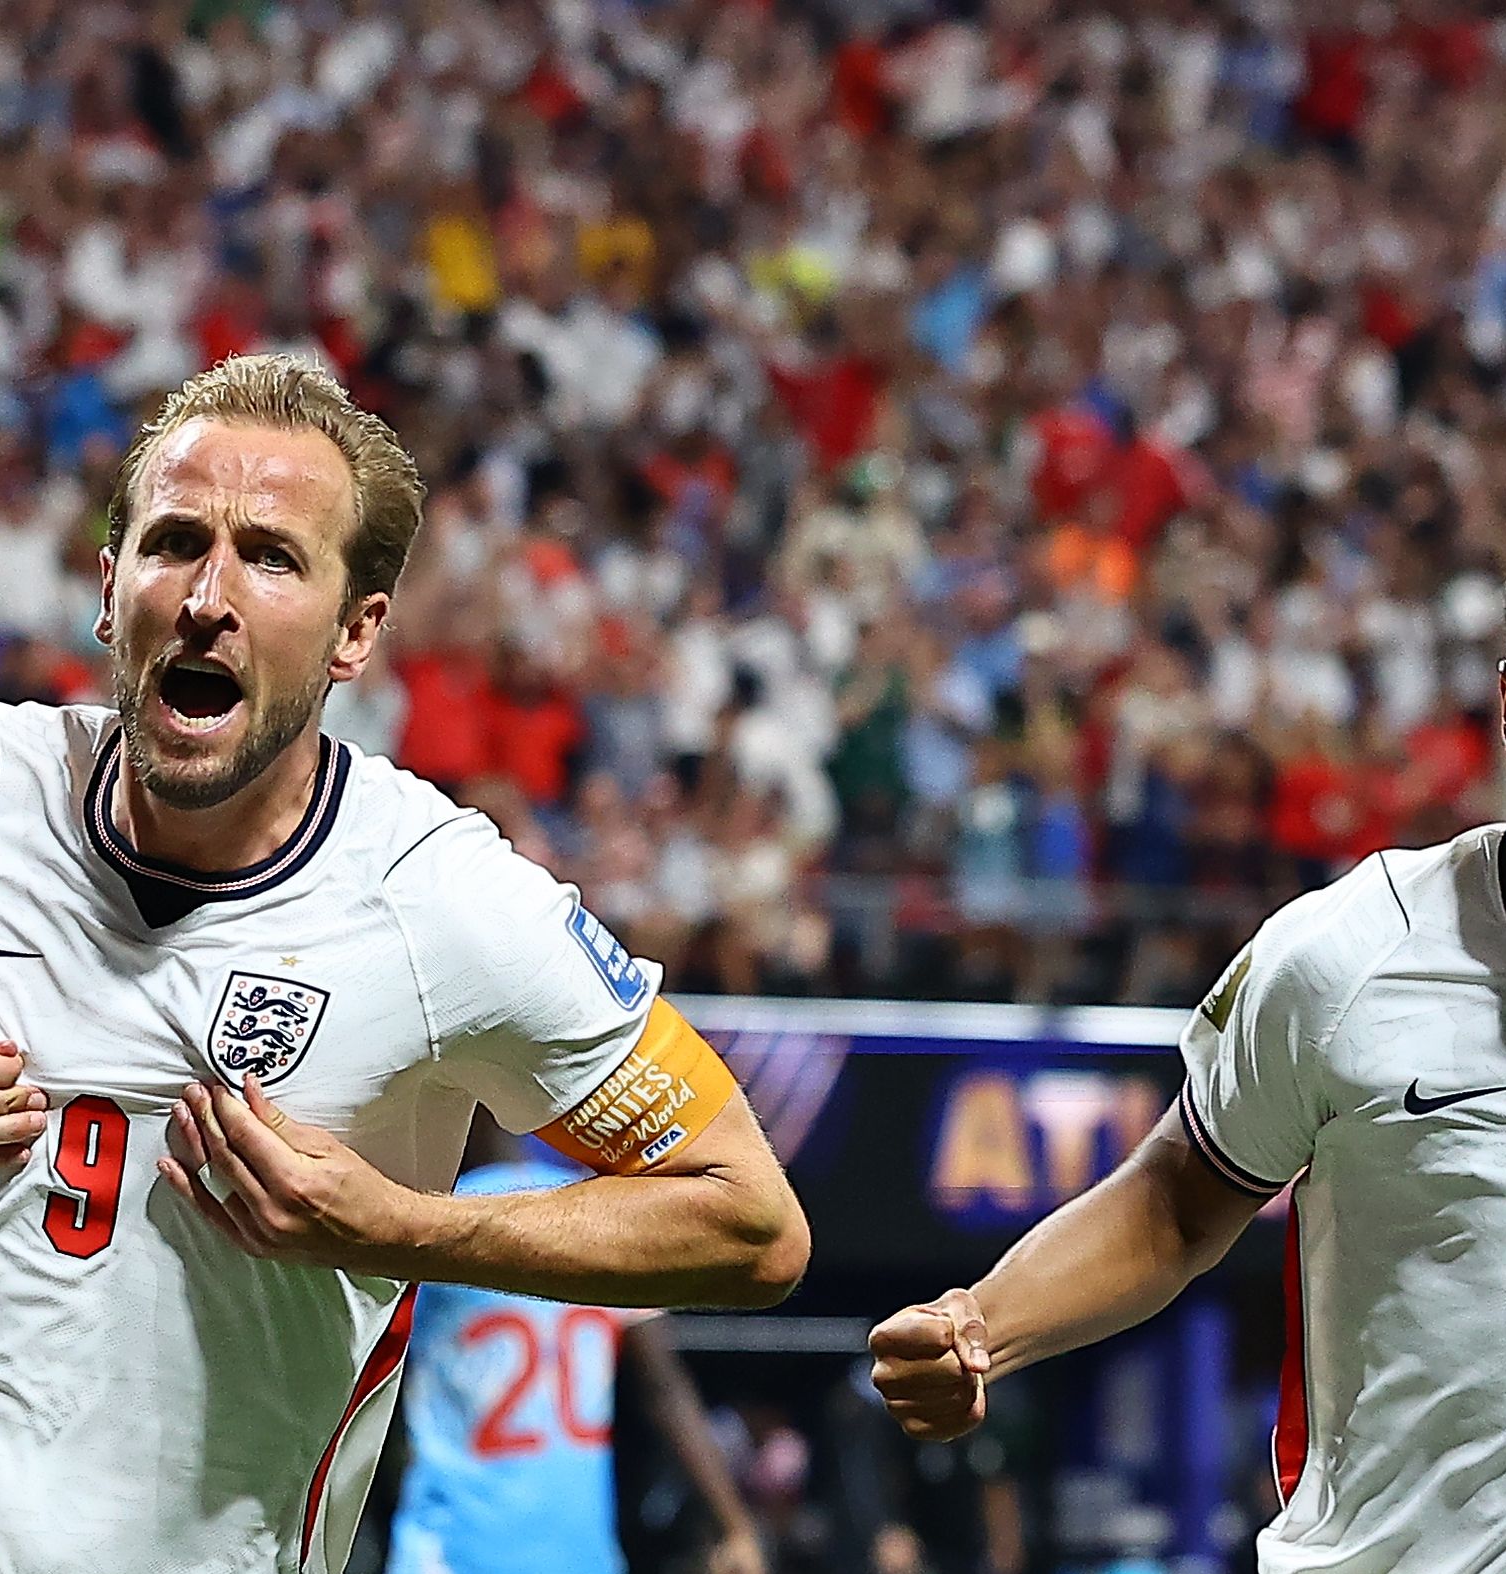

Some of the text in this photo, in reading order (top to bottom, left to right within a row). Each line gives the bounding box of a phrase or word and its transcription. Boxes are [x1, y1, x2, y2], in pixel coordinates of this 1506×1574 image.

[562, 1052, 652, 1134] FOOTBALL
[576, 1064, 672, 1149] UNITES
[600, 1077, 696, 1163] the World
[42, 1094, 130, 1260] 9
[644, 1129, 683, 1160] FIFA
[462, 1305, 624, 1460] 20
